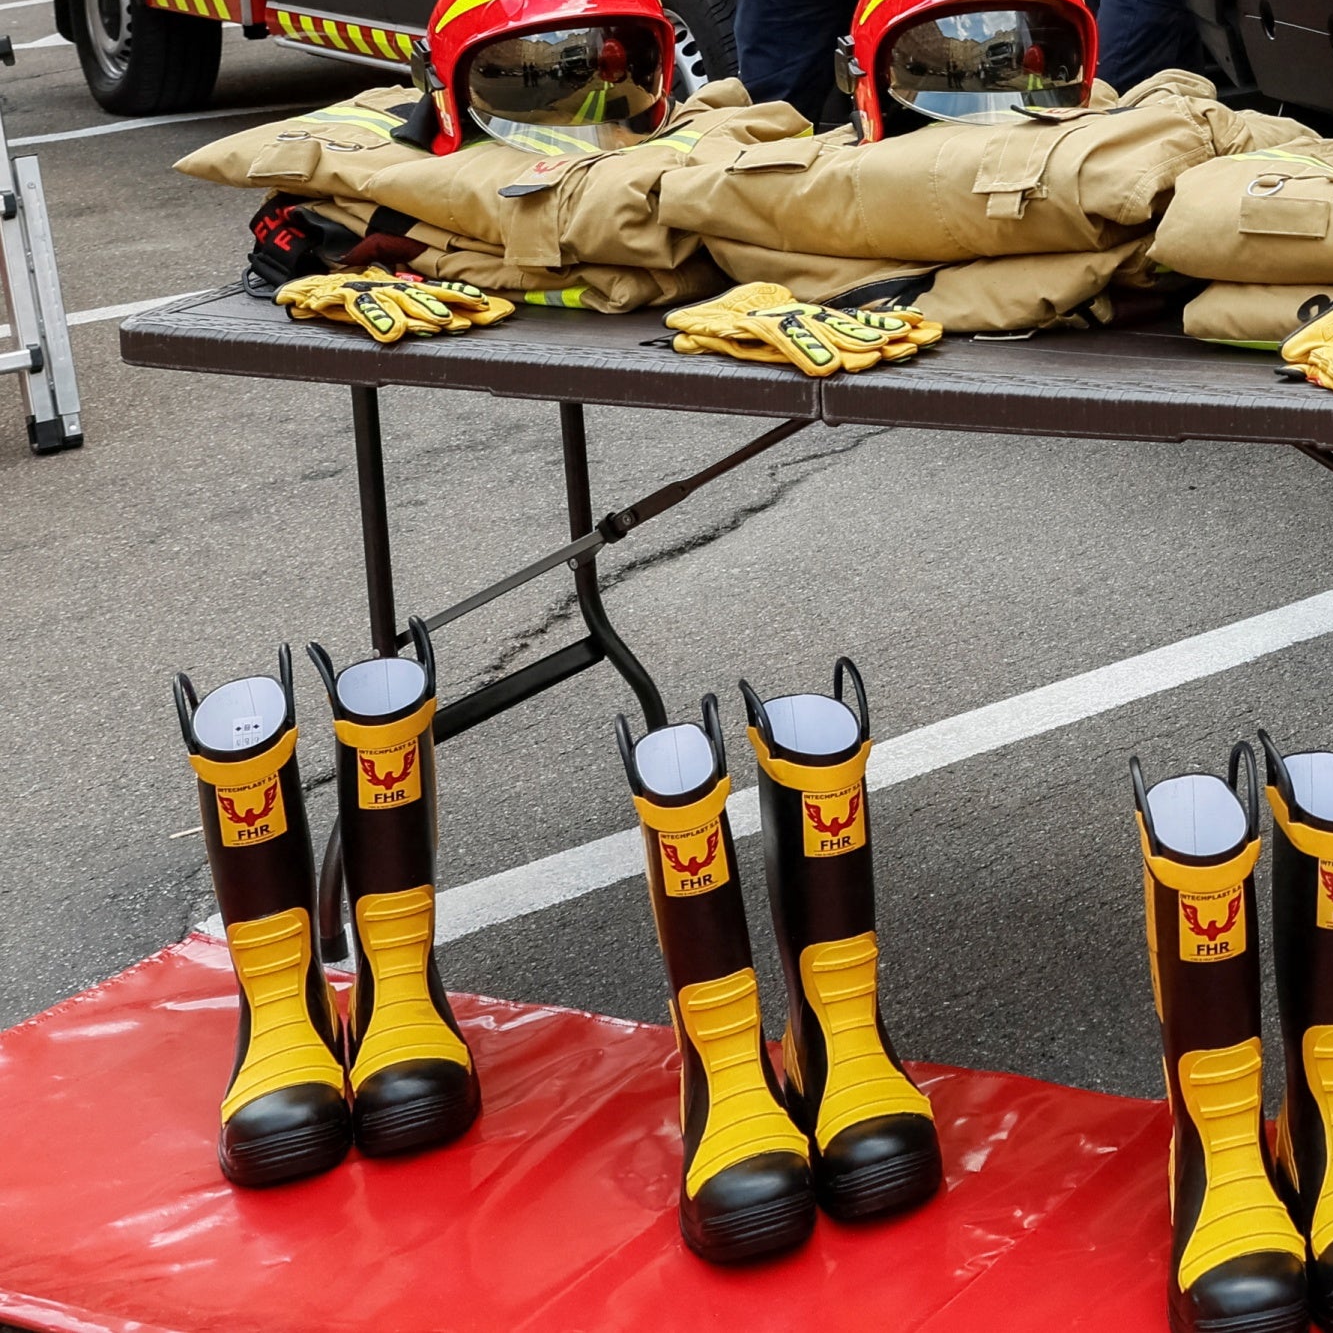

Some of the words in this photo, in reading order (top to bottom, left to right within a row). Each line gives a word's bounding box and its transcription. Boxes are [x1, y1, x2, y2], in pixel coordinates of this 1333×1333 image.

[374, 789, 405, 804] FHR
[238, 824, 270, 840] FHR
[821, 836, 851, 851] FHR
[681, 874, 712, 890] FHR
[1197, 942, 1229, 955] FHR
